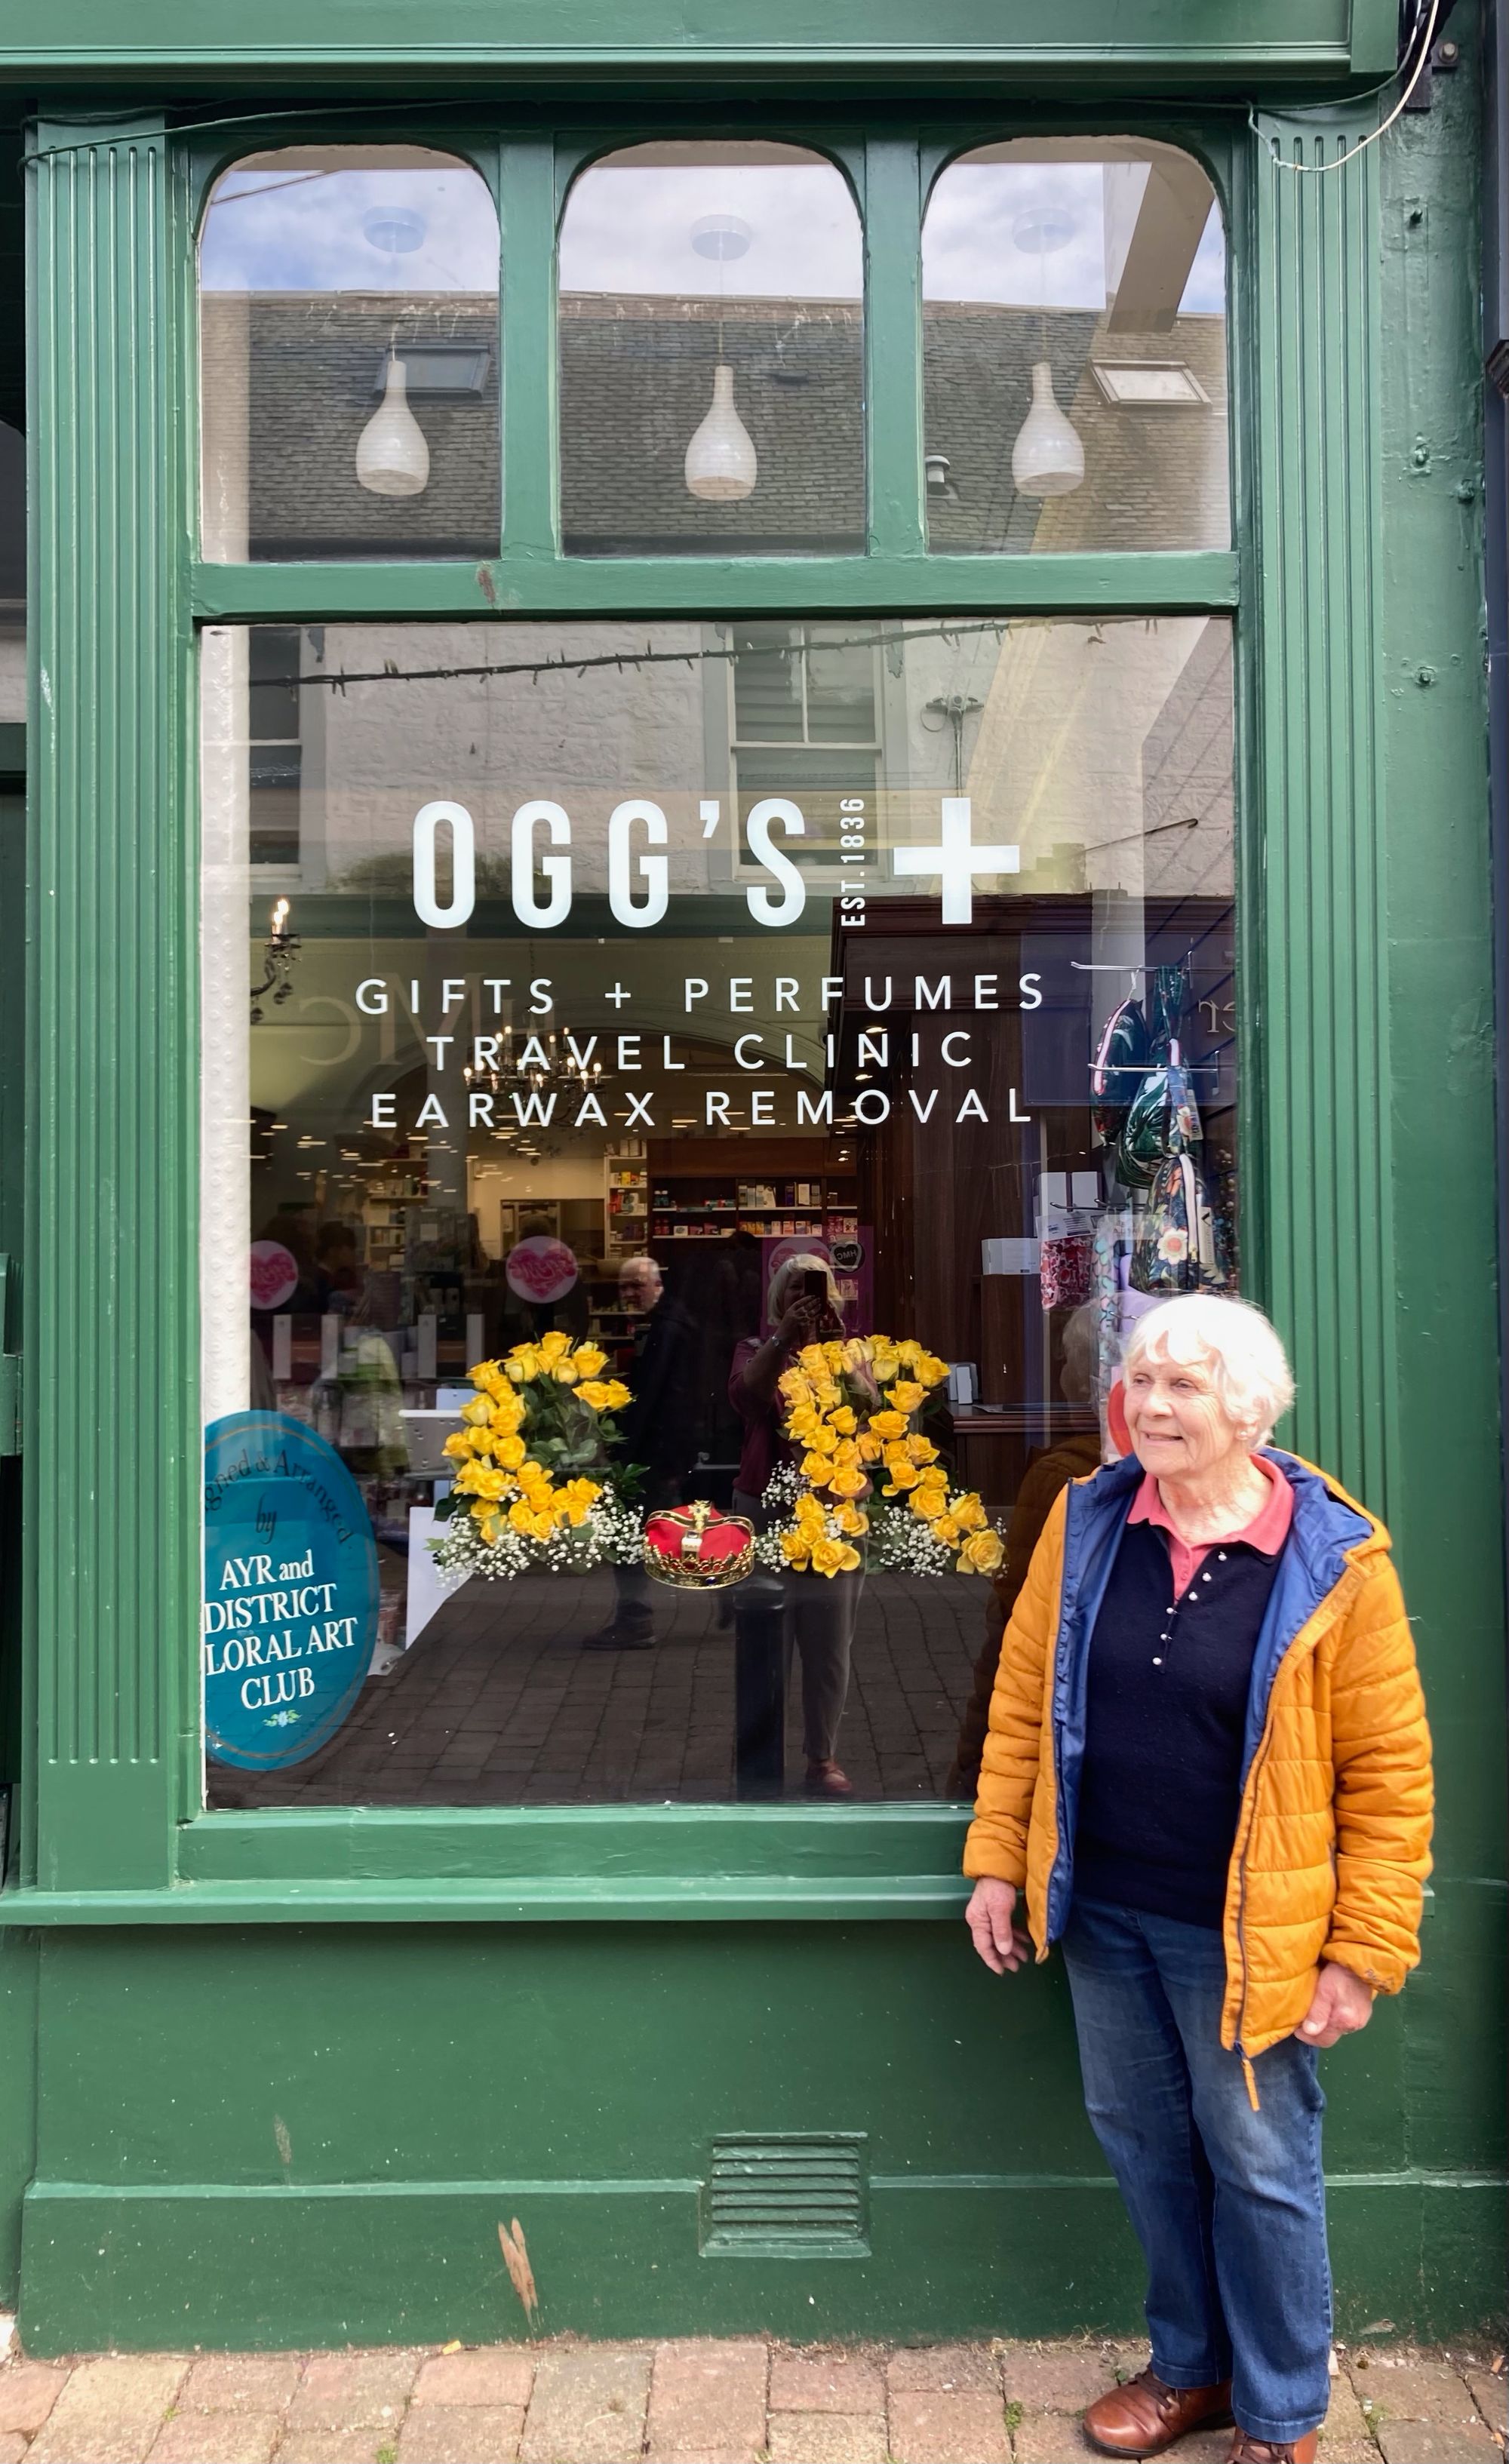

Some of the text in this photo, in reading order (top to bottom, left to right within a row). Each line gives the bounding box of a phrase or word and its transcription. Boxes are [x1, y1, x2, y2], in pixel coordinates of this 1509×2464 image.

[355, 979, 554, 1015] GIFTS
[684, 973, 1043, 1012] PERFUMES
[426, 1031, 973, 1071] TRAVEL CLINIC
[371, 1088, 1031, 1129] EARWAX REMOVAL
[255, 1492, 277, 1545] by
[219, 1549, 315, 1591] AYR and
[204, 1584, 338, 1634] DISTRICT
[205, 1617, 359, 1676] LORAL ART
[241, 1667, 315, 1710] CLUB
